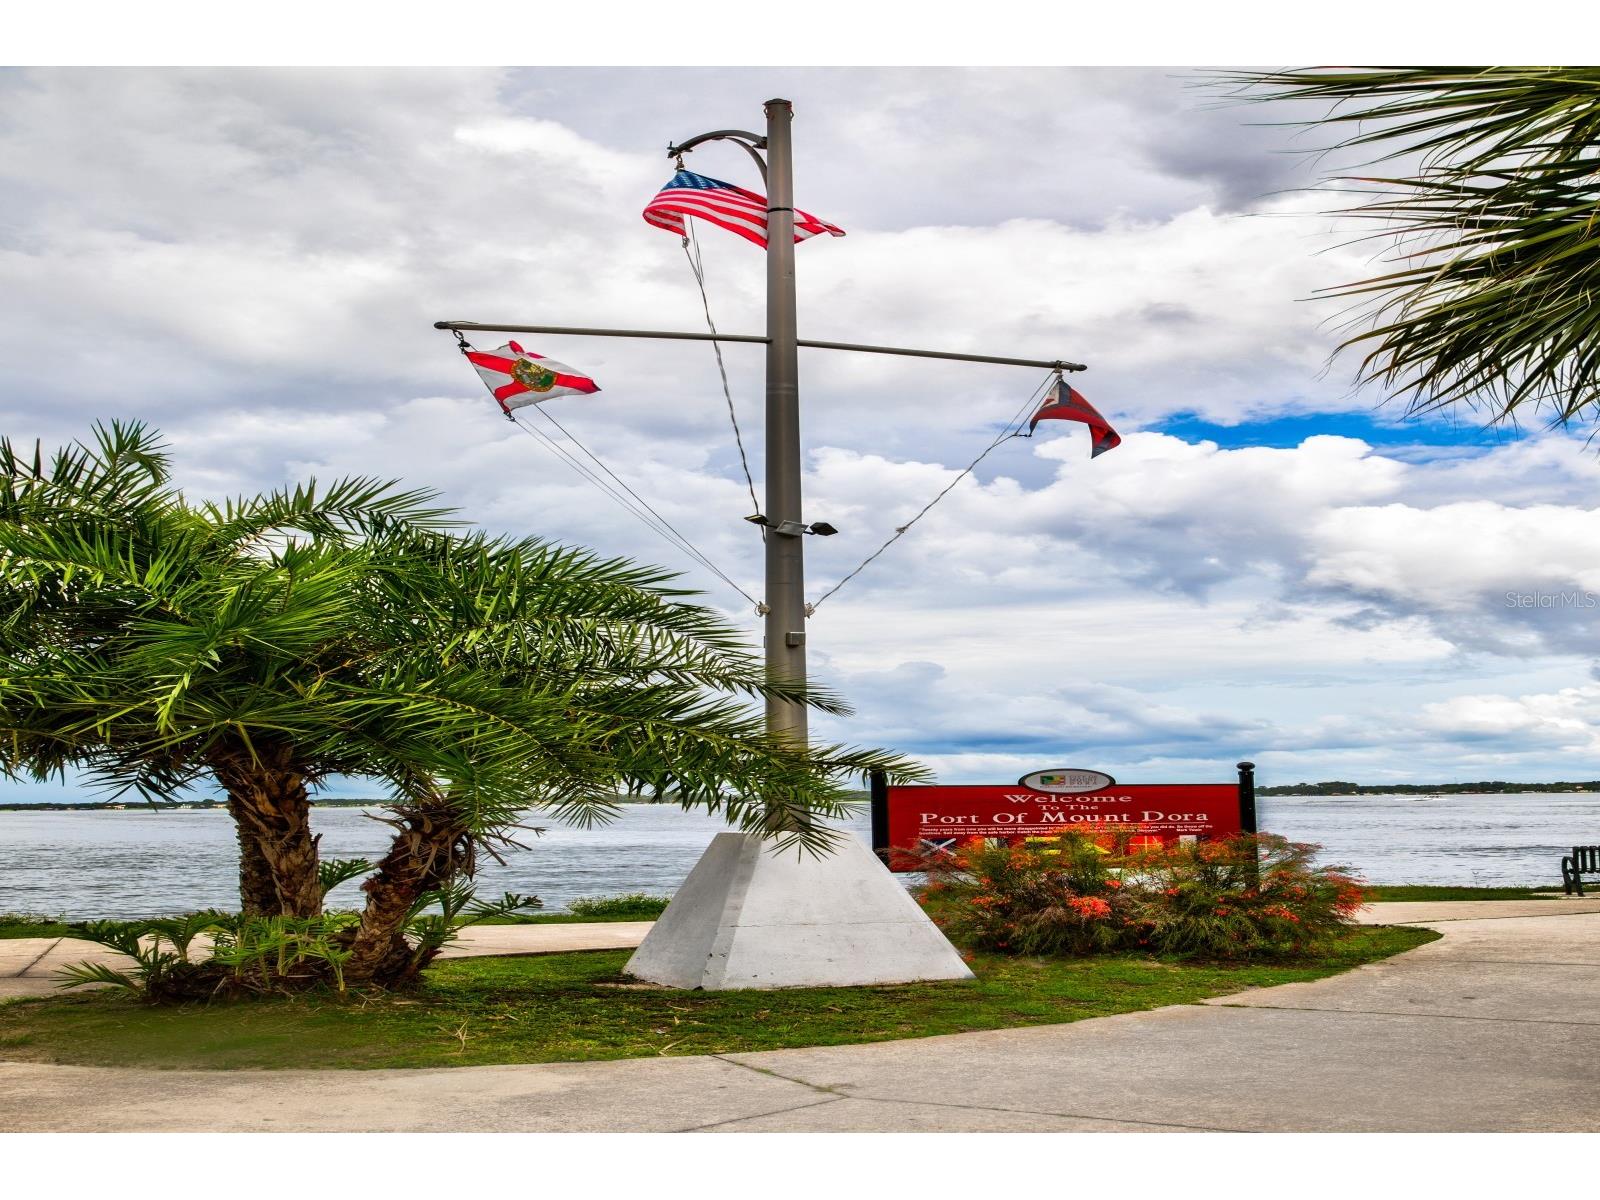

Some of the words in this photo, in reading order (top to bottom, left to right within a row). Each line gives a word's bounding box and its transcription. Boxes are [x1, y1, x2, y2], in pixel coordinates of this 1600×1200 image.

[1003, 794, 1133, 803] Welcome
[920, 812, 980, 824] Port
[992, 812, 1028, 824] Of
[1040, 811, 1131, 822] Mount
[1141, 811, 1209, 822] Dora
